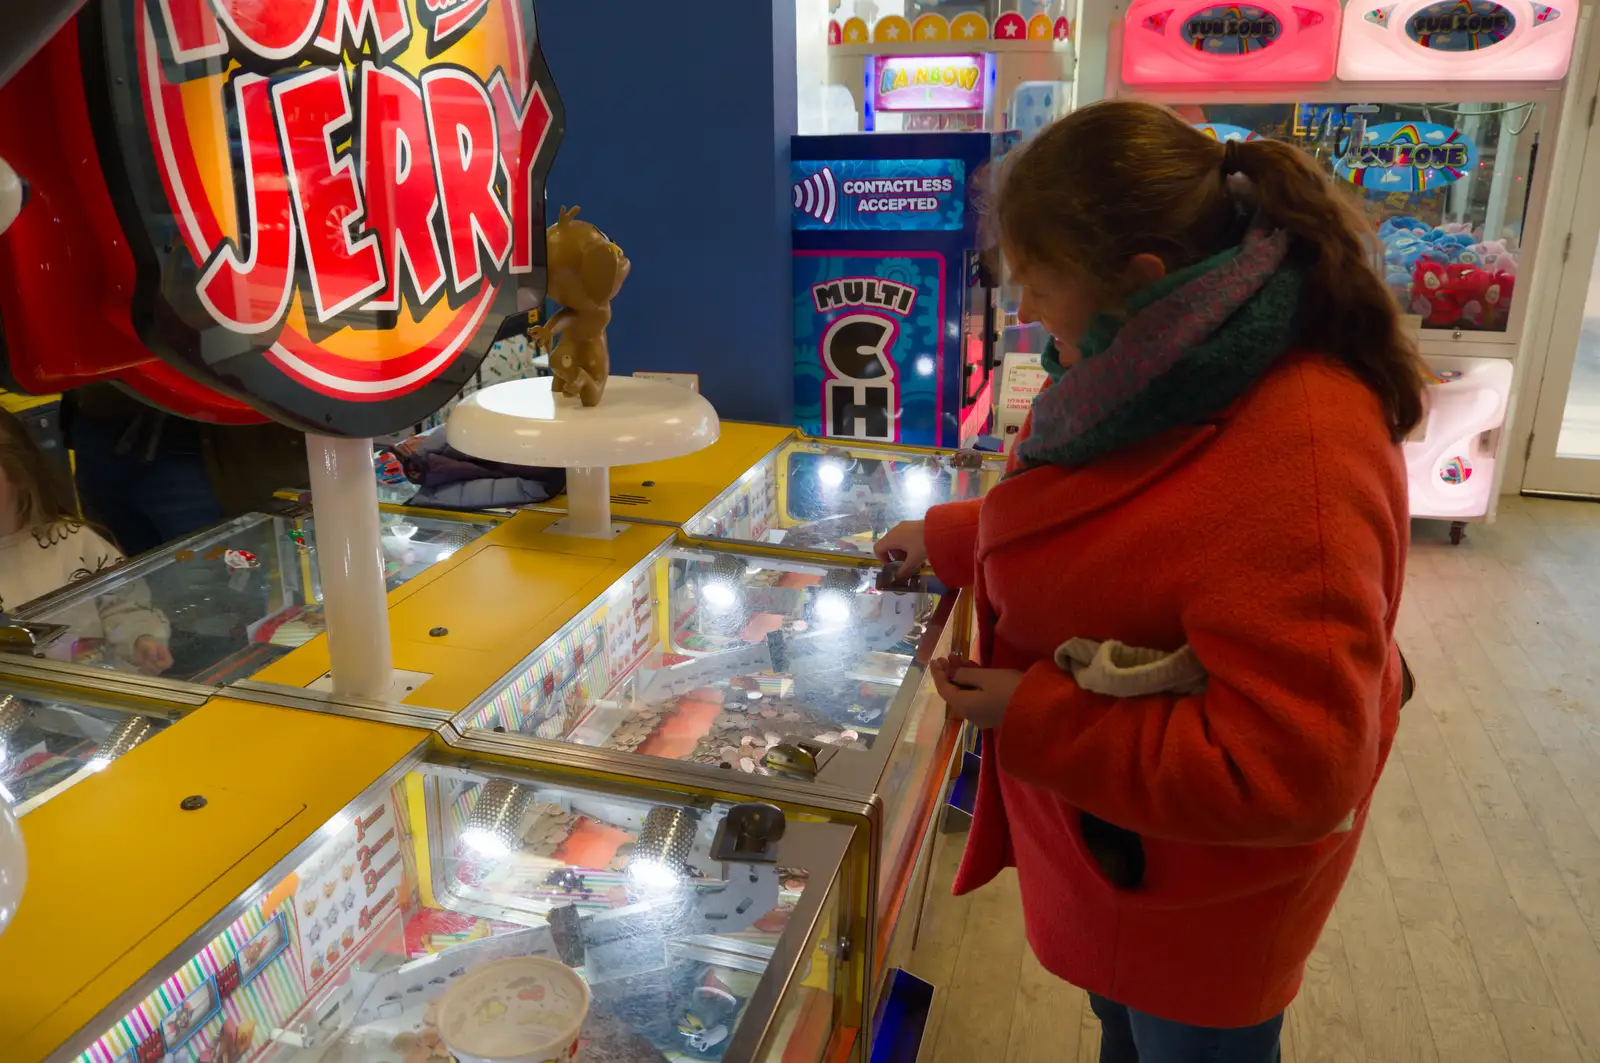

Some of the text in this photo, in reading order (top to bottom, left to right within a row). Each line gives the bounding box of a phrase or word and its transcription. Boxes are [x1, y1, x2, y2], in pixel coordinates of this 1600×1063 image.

[1227, 19, 1273, 35] ZONE
[1456, 14, 1507, 31] ZONE
[1399, 146, 1464, 166] ZONE
[843, 178, 953, 195] CONTACTLESS
[196, 62, 553, 334] JERRY
[857, 196, 938, 212] ACCEPTED
[815, 280, 914, 311] MULTI
